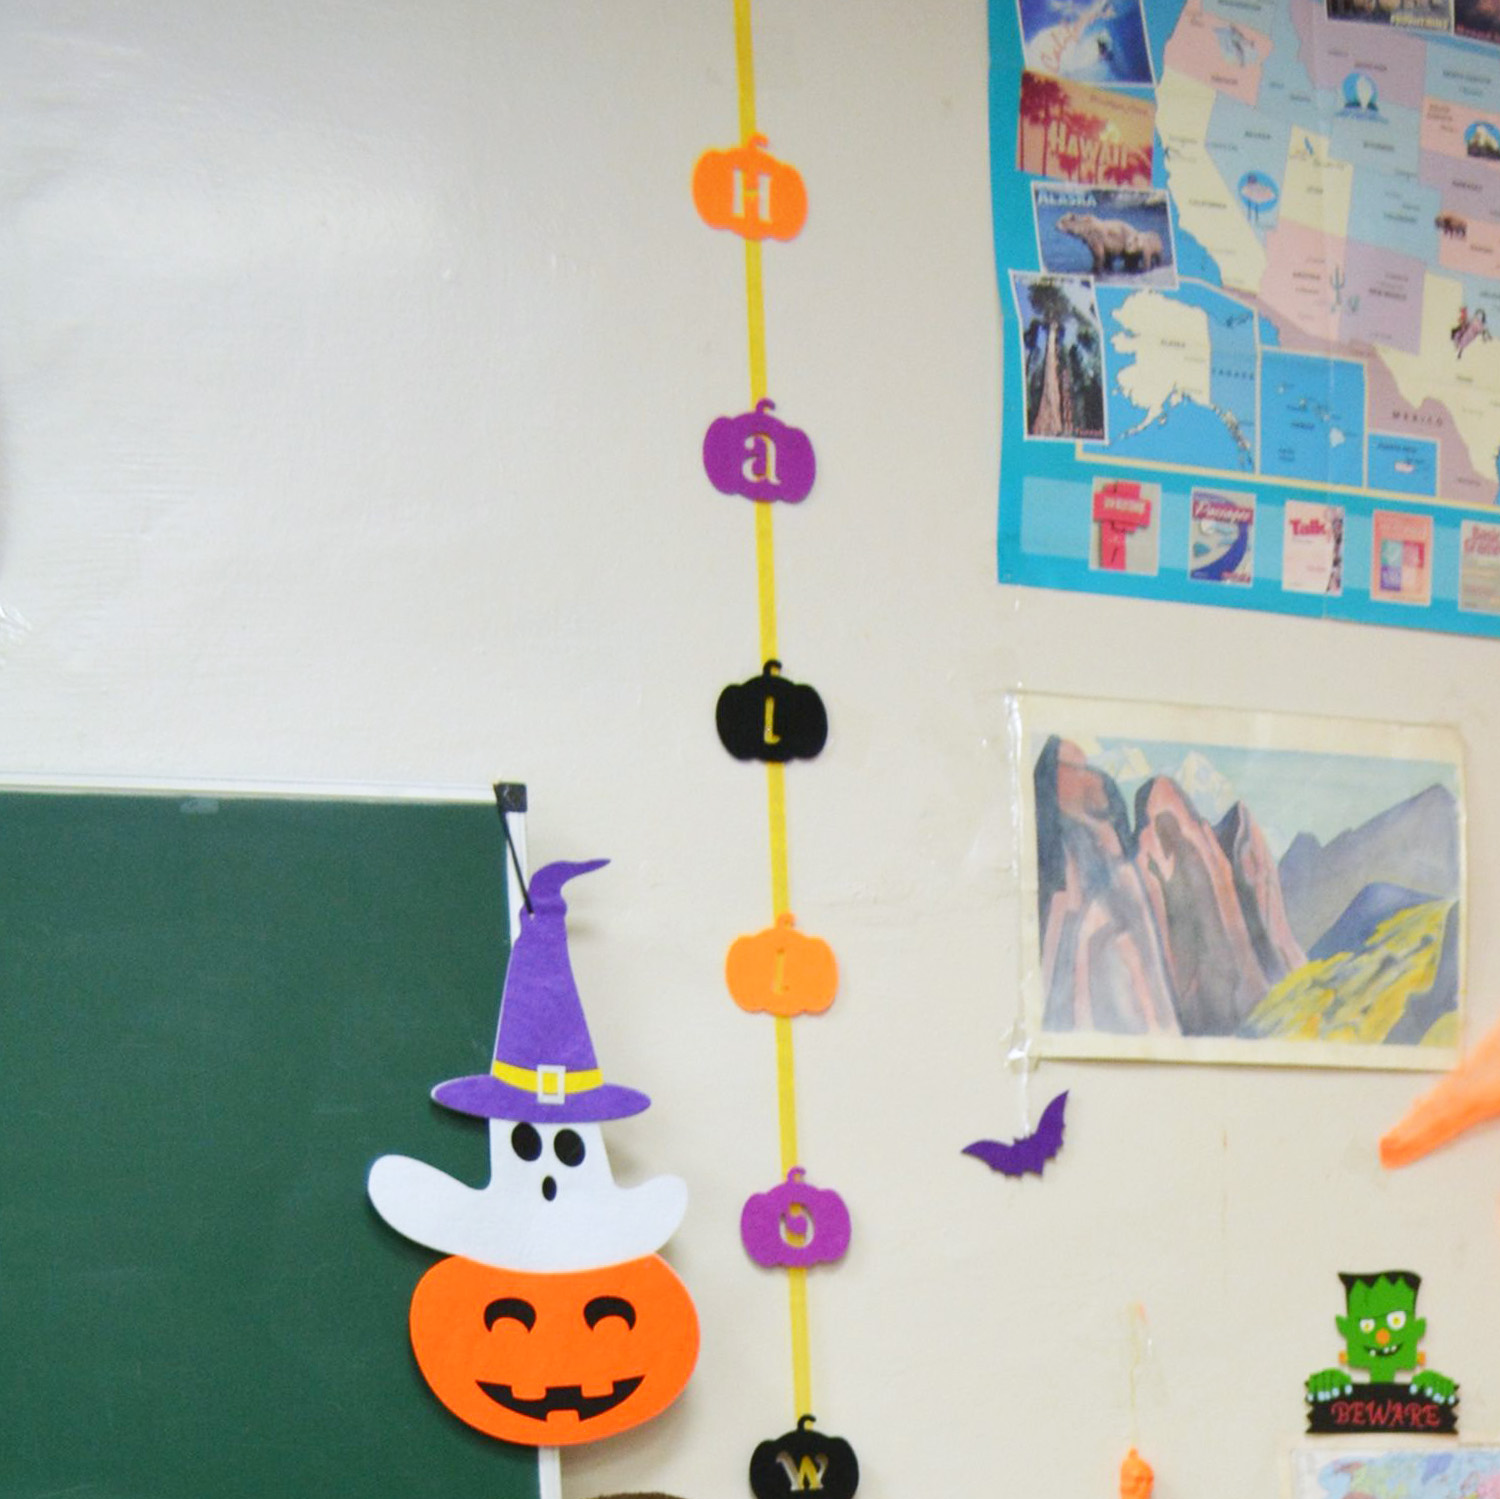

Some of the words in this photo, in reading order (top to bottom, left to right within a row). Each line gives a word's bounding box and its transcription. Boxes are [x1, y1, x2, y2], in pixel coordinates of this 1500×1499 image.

[1049, 119, 1128, 164] HAWAII
[1036, 189, 1098, 207] ALASKA
[1290, 516, 1326, 537] Talk
[1331, 1400, 1441, 1428] BEWARE
